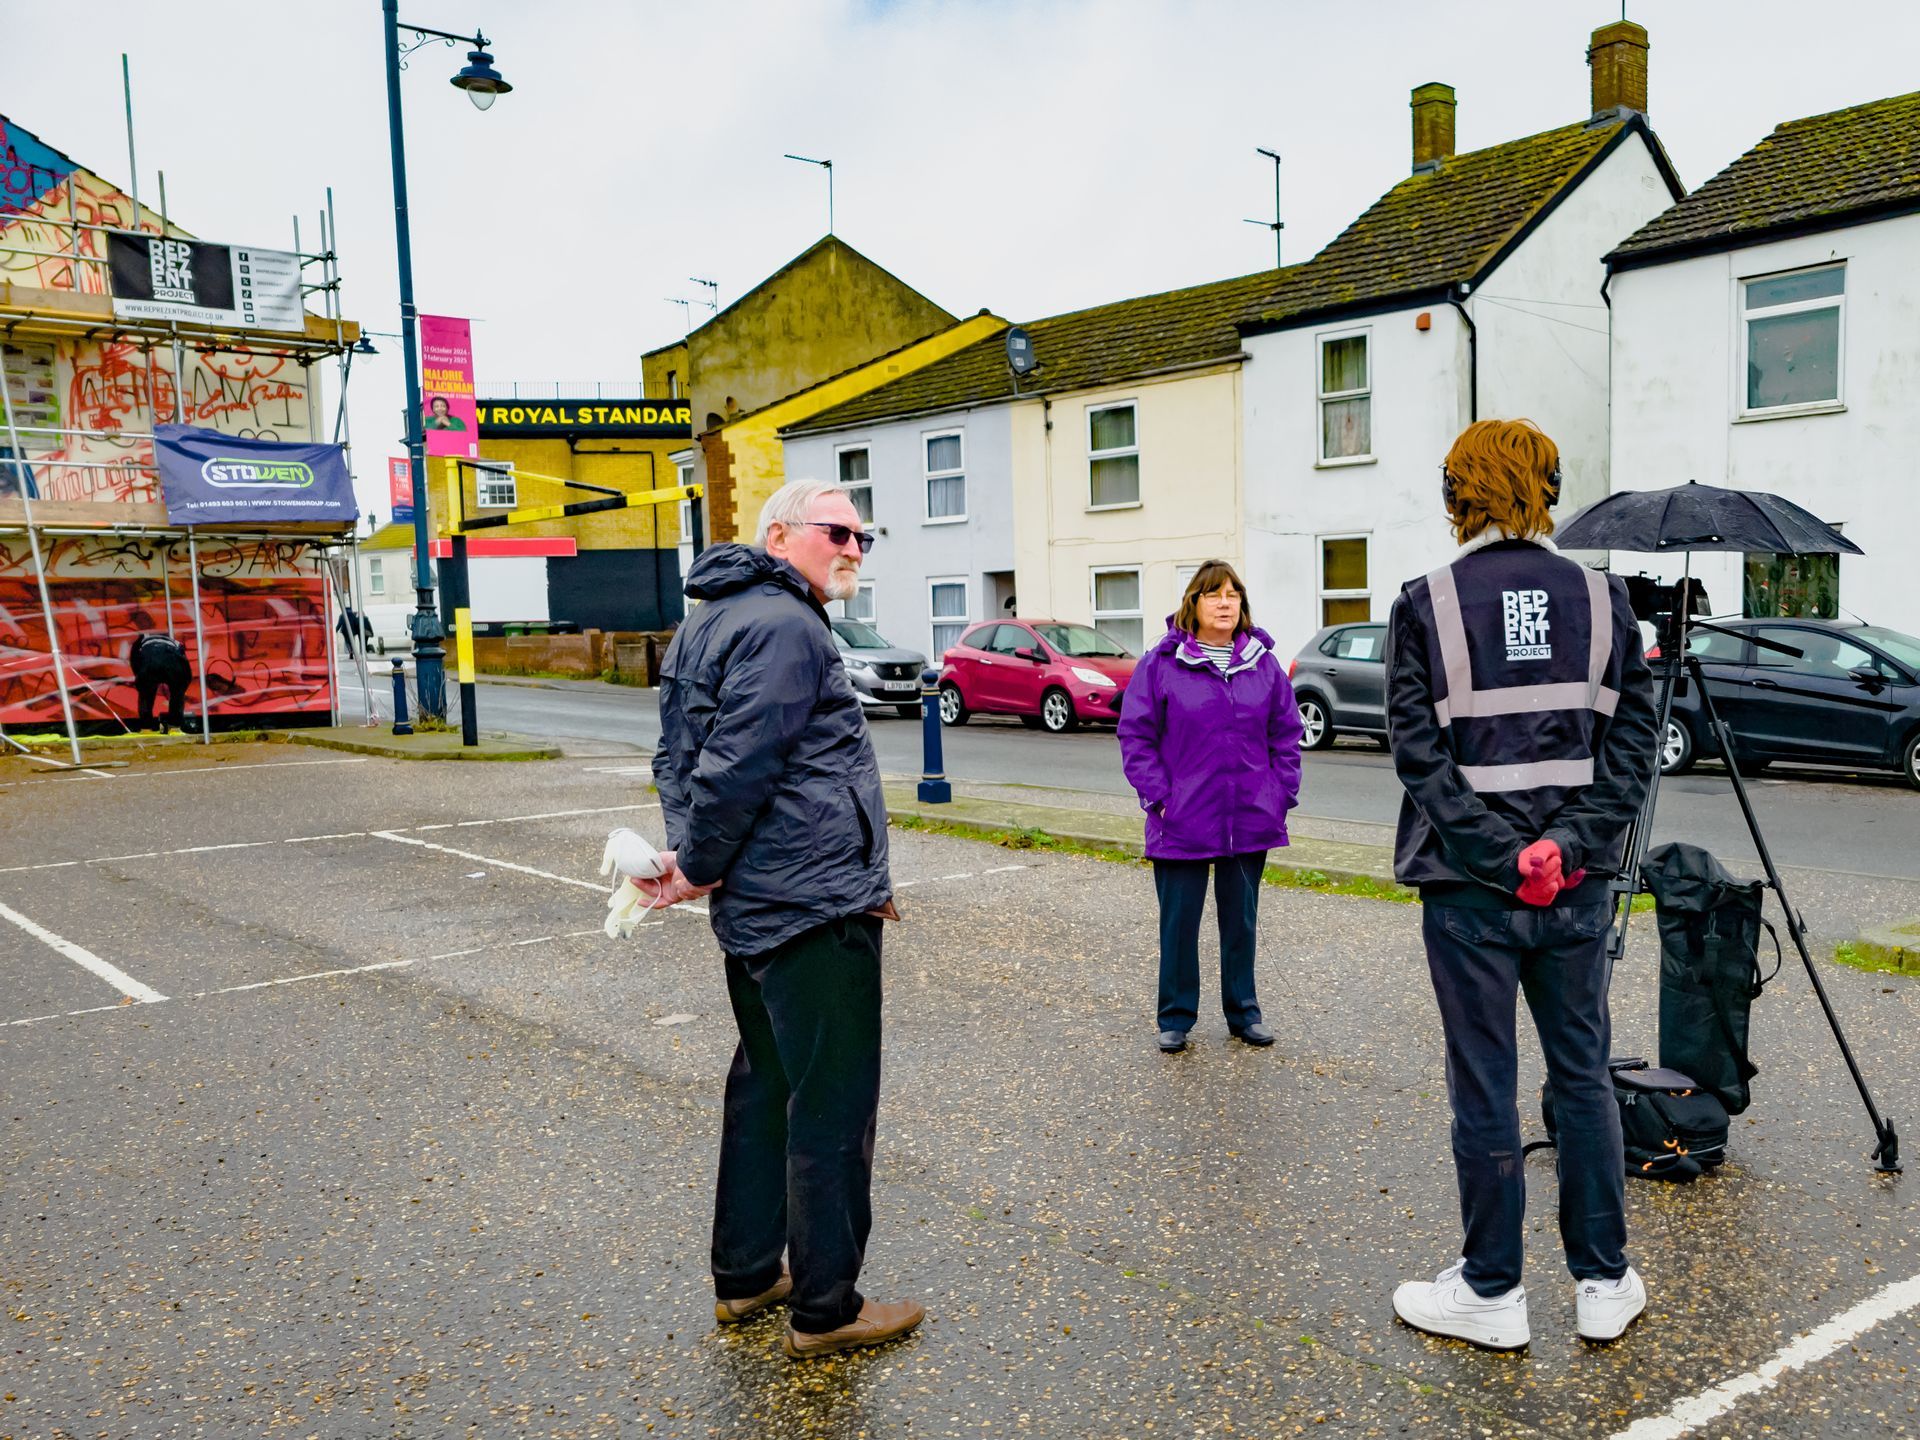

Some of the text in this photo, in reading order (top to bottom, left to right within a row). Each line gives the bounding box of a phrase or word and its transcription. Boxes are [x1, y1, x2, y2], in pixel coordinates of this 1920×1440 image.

[154, 289, 194, 300] PROJECT
[424, 368, 464, 381] MALORIE
[424, 380, 474, 394] BLACKMAN
[493, 407, 574, 424] ROYAL
[211, 464, 305, 482] STOWEN
[1502, 590, 1549, 611] REP
[1505, 625, 1550, 645] ENT
[1506, 647, 1551, 657] PROJECT
